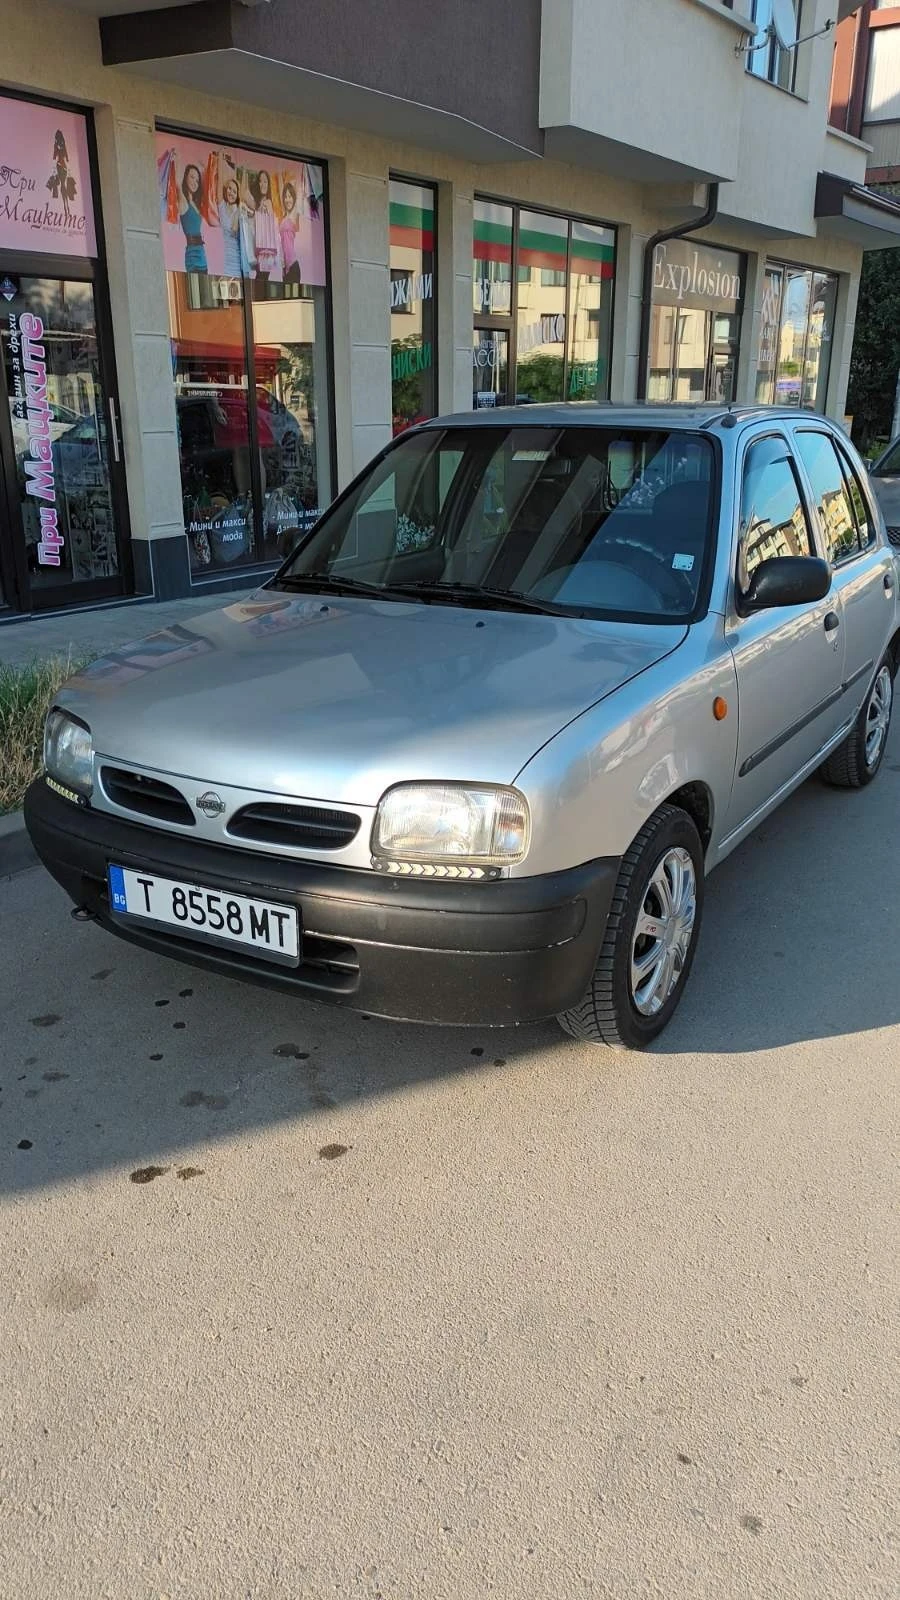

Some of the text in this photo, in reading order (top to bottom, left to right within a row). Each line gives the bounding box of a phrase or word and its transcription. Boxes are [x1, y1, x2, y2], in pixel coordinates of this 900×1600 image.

[653, 243, 741, 300] Explosion
[7, 313, 20, 353] дрехи
[12, 358, 20, 372] за
[20, 312, 64, 566] При Мацките
[189, 517, 246, 532] Мини и макси
[222, 531, 243, 543] мода
[114, 878, 290, 947] BG T 8558 MT
